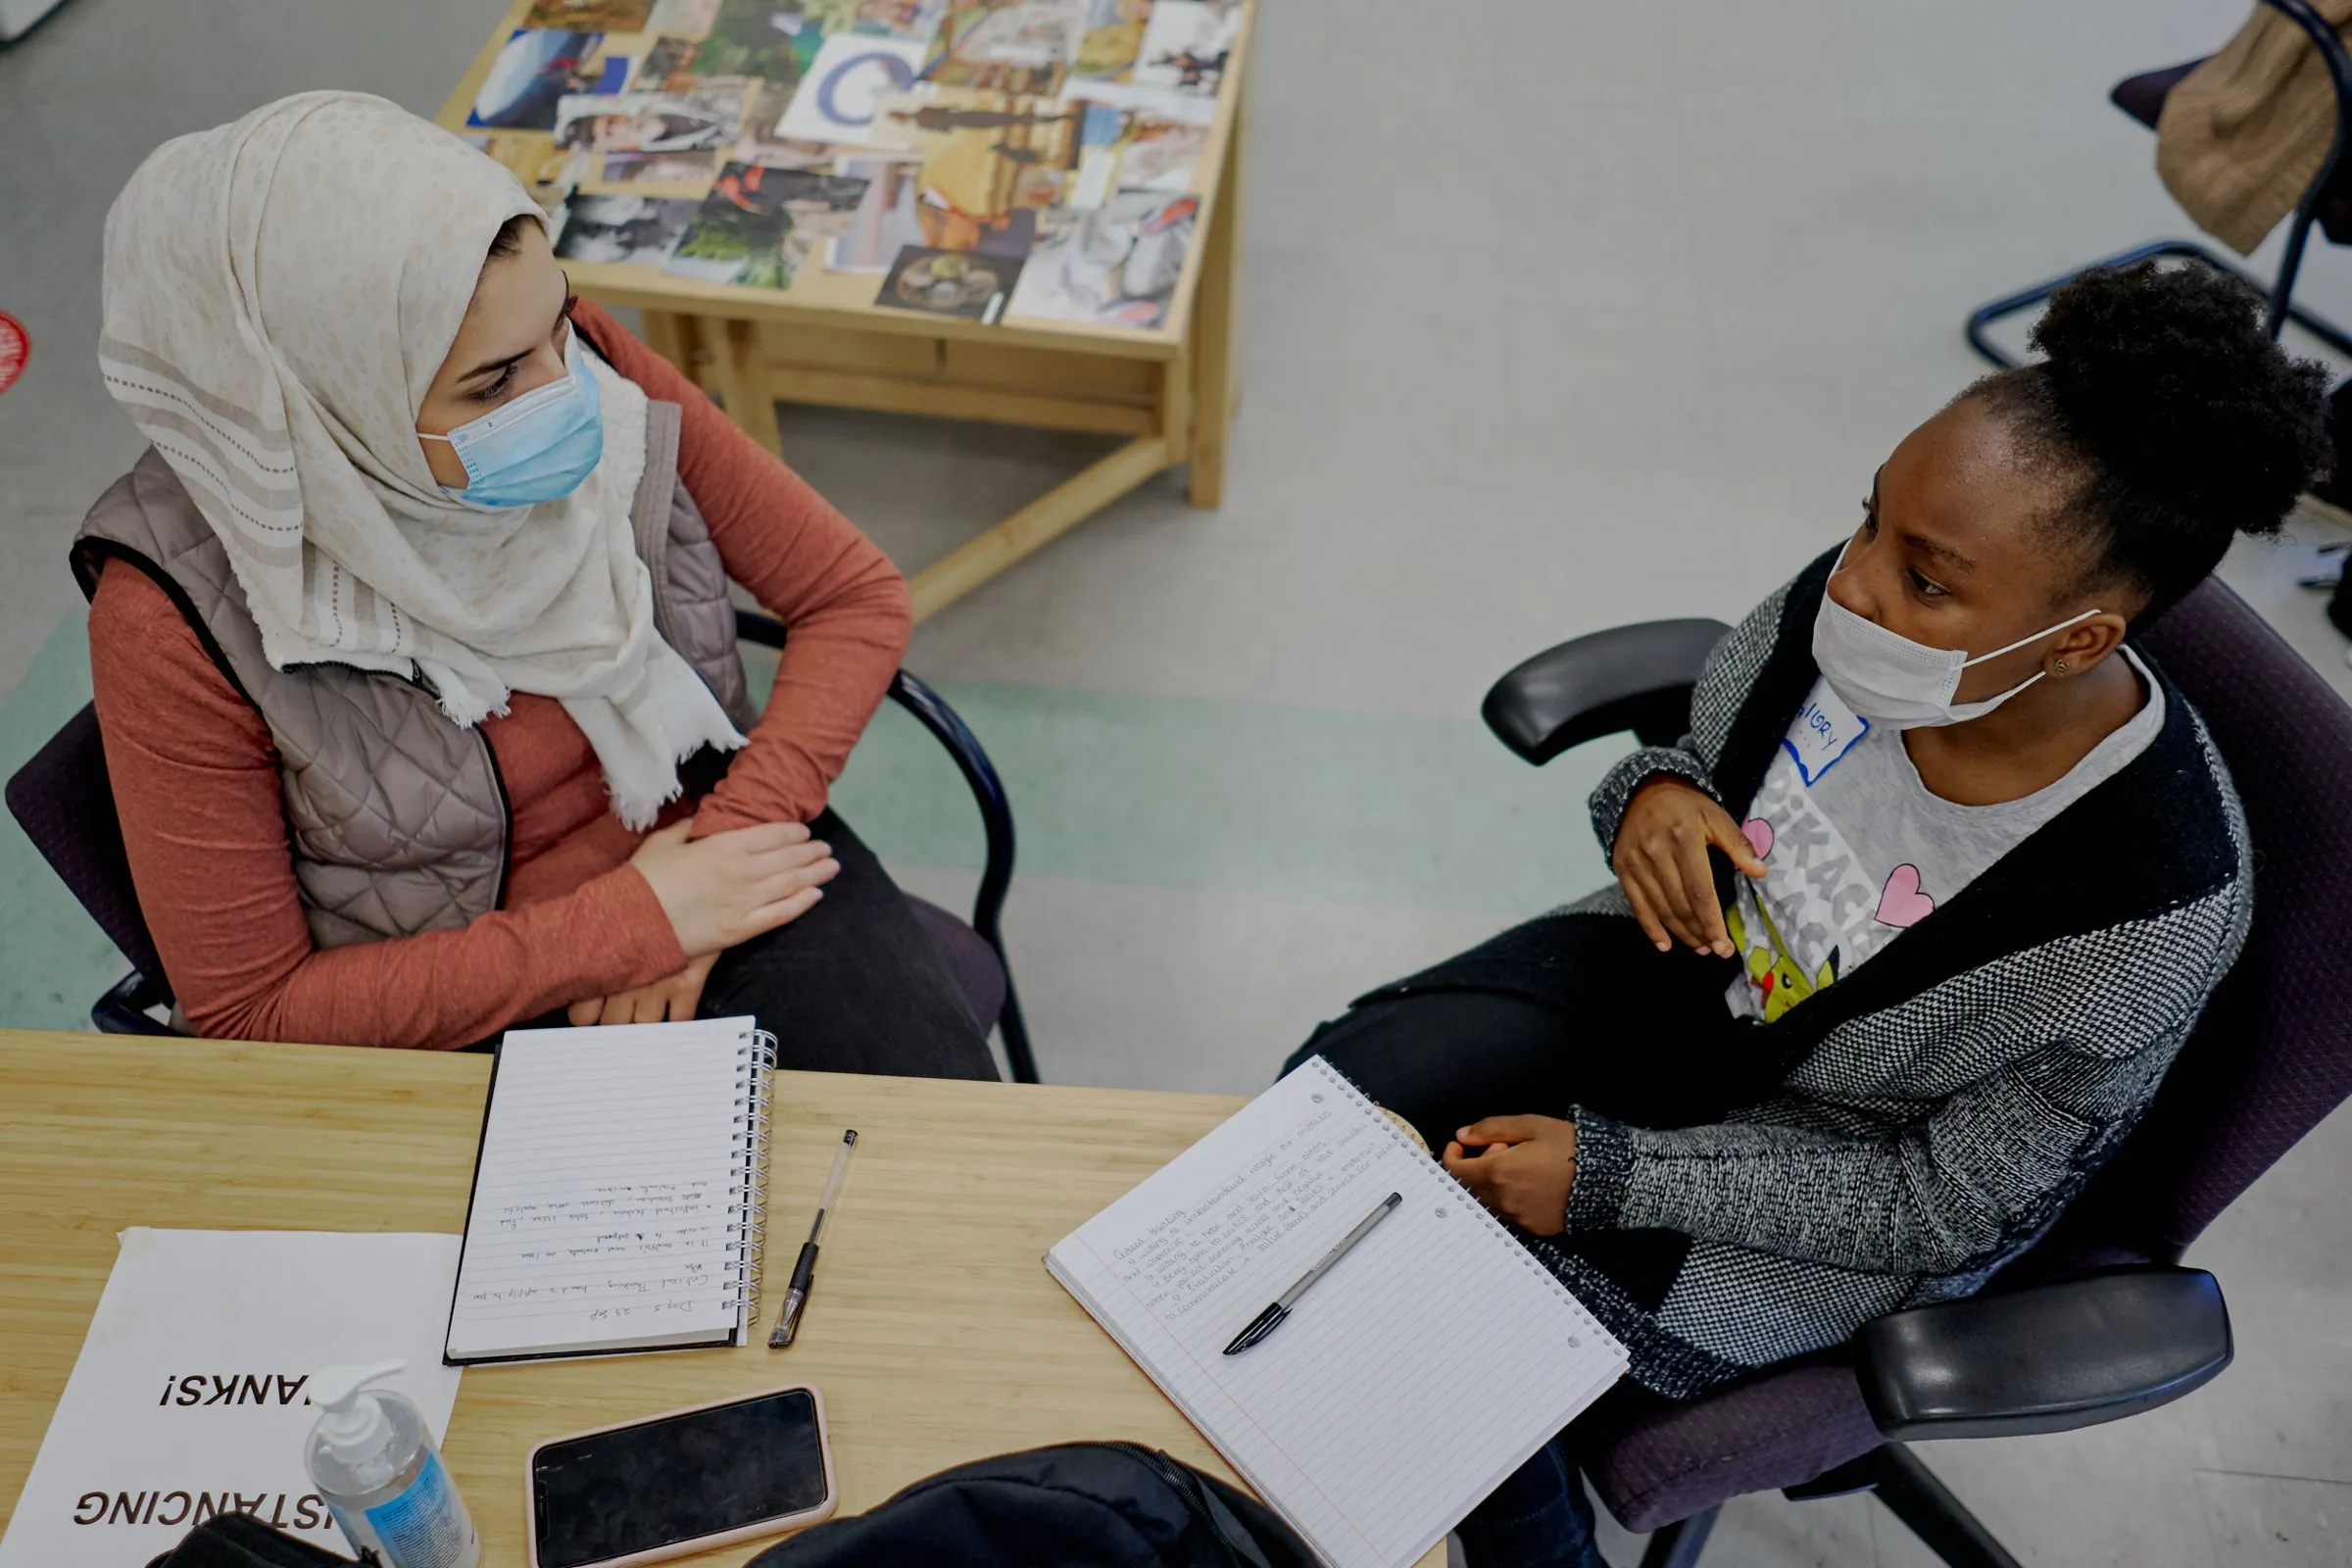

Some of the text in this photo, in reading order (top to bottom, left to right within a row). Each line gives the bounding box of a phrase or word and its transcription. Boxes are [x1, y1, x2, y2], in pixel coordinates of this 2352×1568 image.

[607, 1279, 650, 1293] Thinking
[159, 1374, 313, 1406] ANKS!
[73, 1491, 335, 1530] STANCING
